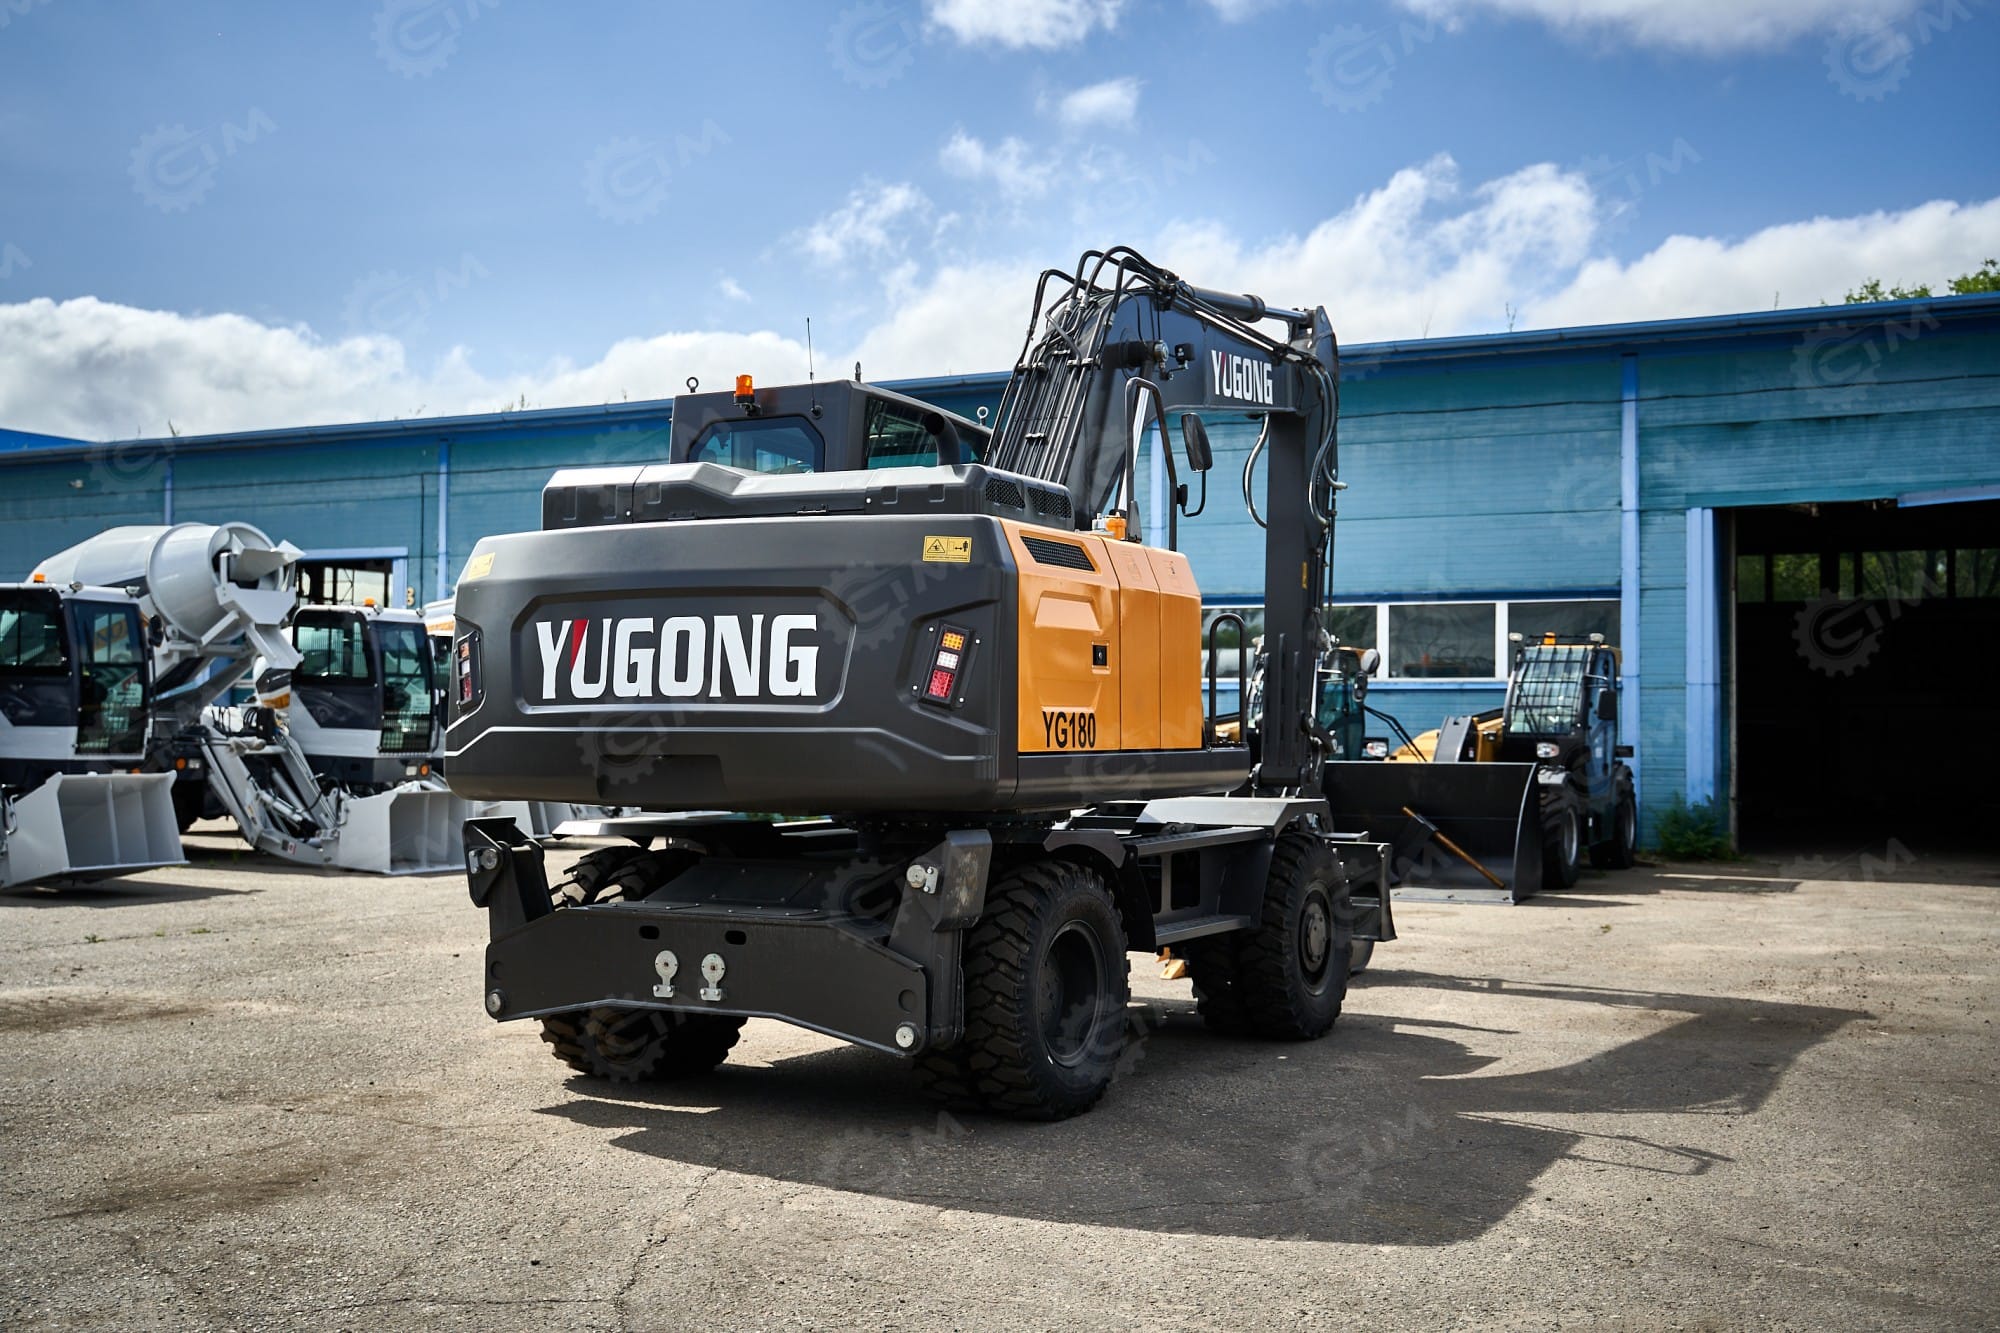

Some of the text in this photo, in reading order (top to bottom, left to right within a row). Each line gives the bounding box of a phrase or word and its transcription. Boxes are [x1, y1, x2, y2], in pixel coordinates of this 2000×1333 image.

[1211, 349, 1274, 405] YUGONG
[536, 614, 820, 700] YUGONG
[1042, 711, 1096, 748] YG180
